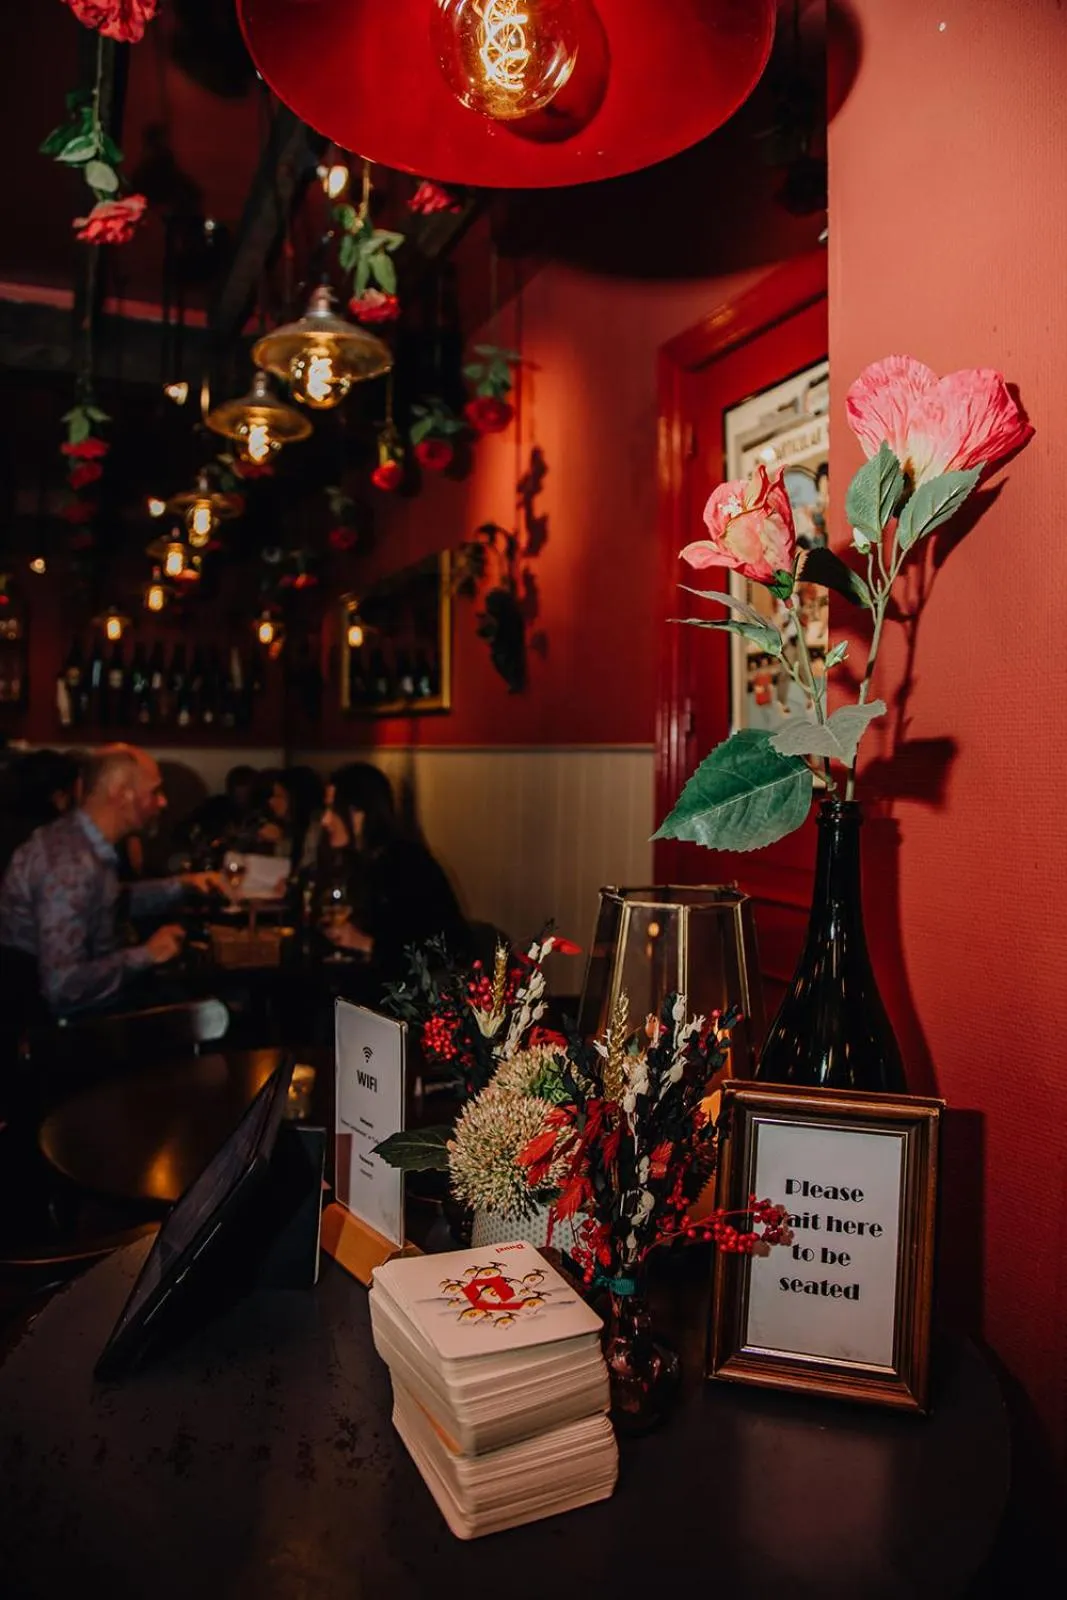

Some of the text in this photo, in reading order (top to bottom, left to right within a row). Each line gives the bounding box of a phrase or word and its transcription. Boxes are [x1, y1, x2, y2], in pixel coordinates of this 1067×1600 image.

[785, 1178, 864, 1203] Please
[778, 1211, 883, 1238] ait here
[792, 1243, 851, 1267] to be
[779, 1276, 860, 1301] seated
